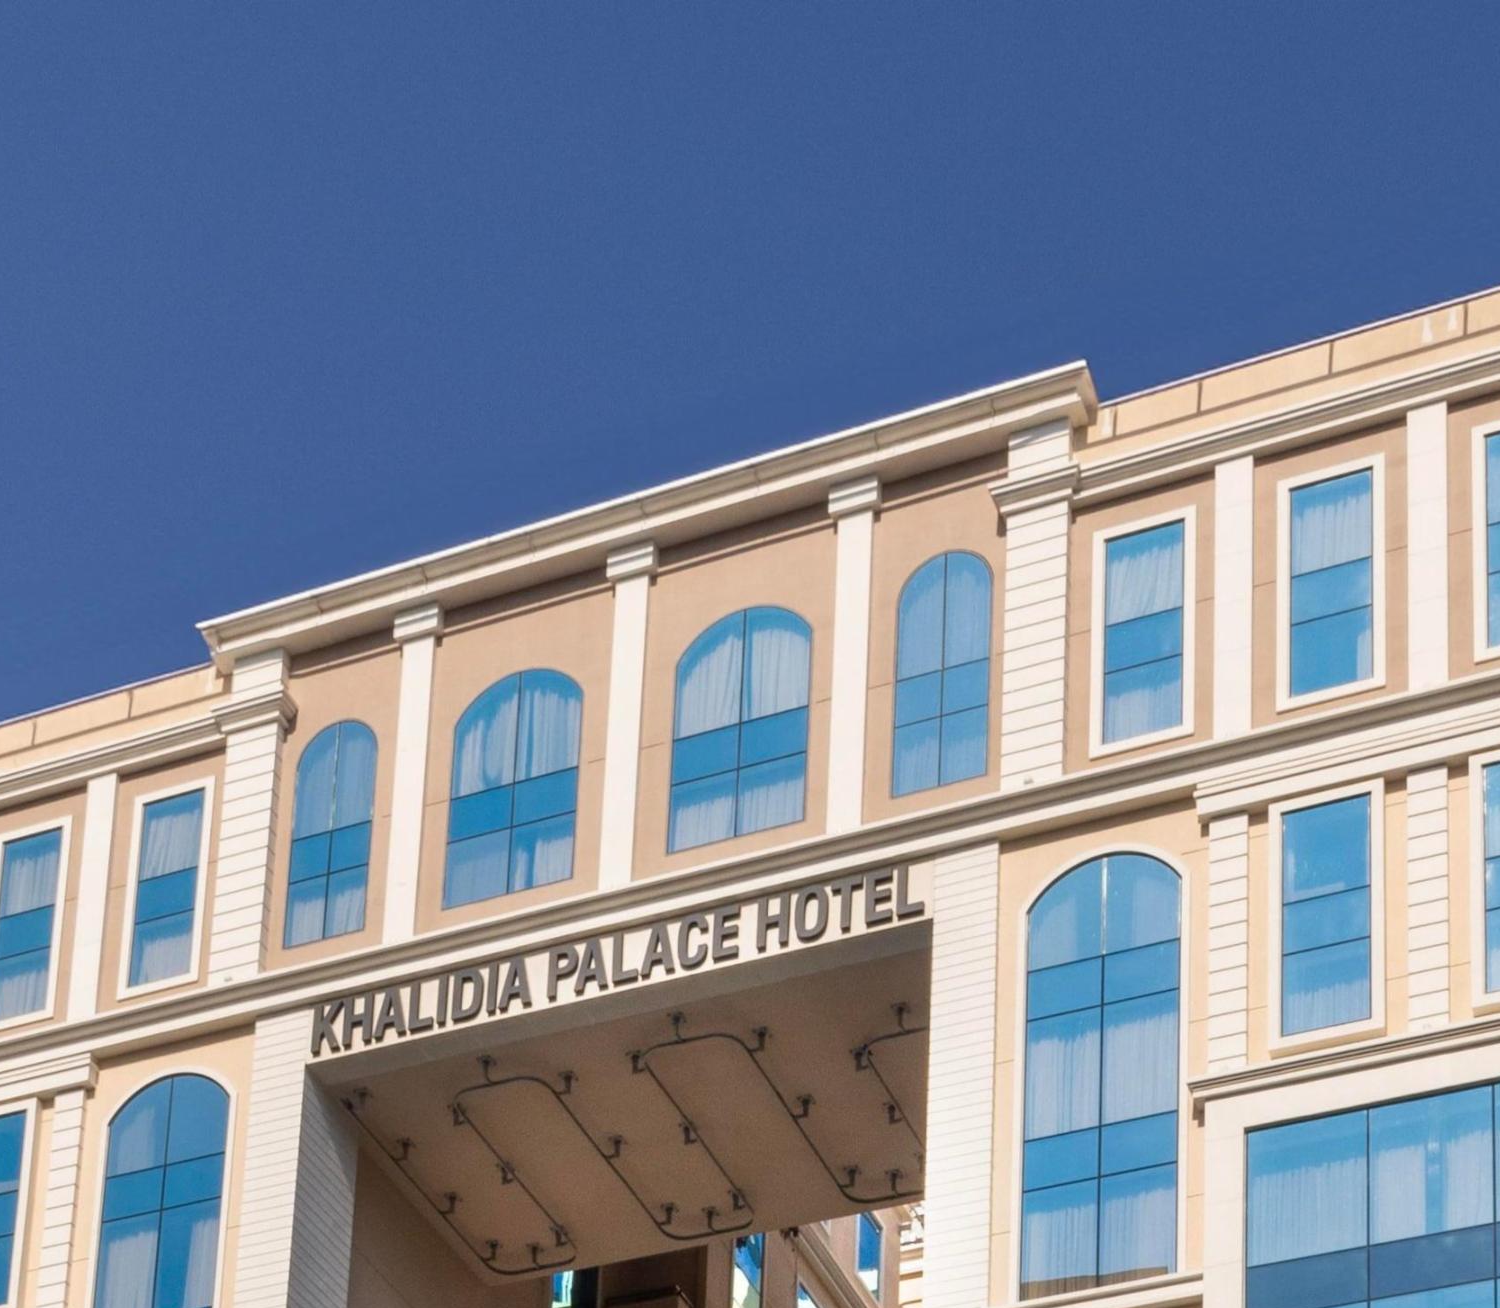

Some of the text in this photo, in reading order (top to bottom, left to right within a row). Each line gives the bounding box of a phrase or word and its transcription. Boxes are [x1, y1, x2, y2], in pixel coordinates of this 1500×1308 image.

[311, 864, 925, 1057] KHALIDIA PALACE HOTEL
